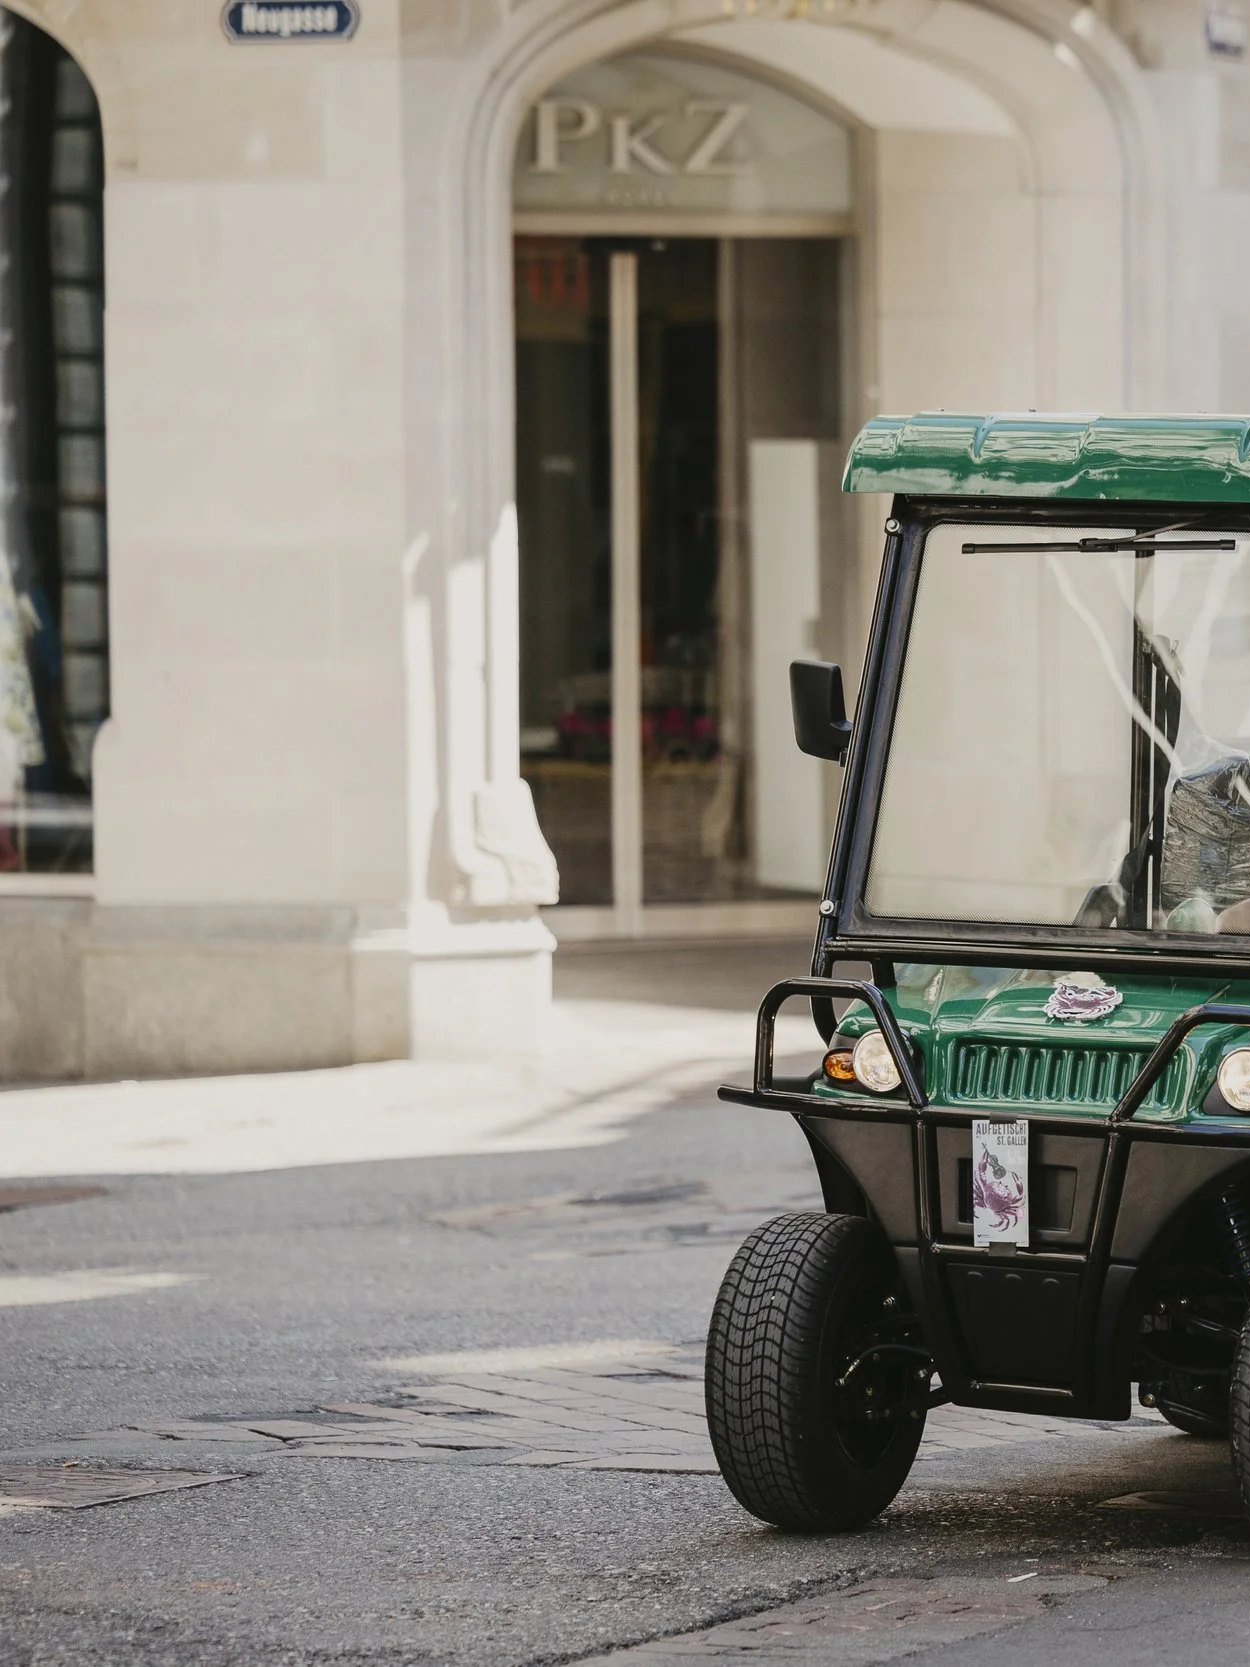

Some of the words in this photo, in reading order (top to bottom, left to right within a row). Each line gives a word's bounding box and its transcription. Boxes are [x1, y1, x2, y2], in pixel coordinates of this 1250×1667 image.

[241, 3, 338, 38] Neugasse
[976, 1122, 1027, 1135] AUFGETISCHT
[1007, 1136, 1026, 1146] GALLEN
